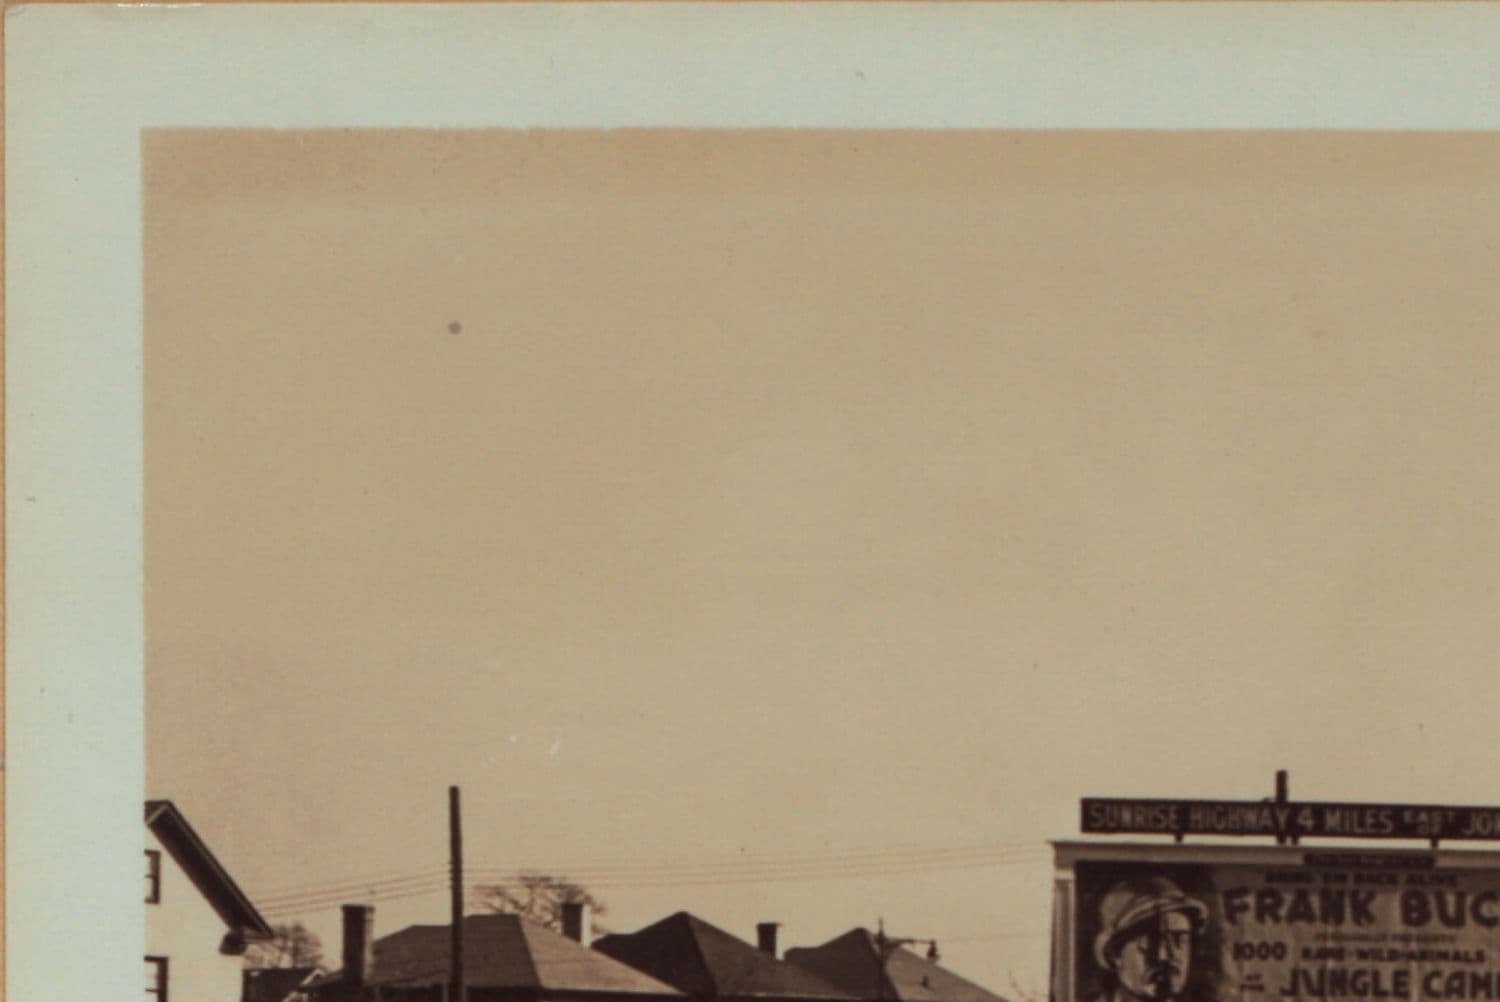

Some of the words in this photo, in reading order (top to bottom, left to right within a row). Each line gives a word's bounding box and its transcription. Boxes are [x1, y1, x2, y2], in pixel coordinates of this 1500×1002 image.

[1090, 802, 1181, 830] SUNRISE
[1190, 803, 1290, 832] HIGHWAY
[1297, 807, 1315, 832] 4
[1325, 807, 1393, 835] MILES
[1222, 887, 1379, 926] FRANK
[1232, 941, 1287, 961] 1000
[1279, 968, 1411, 998] JUNGLE
